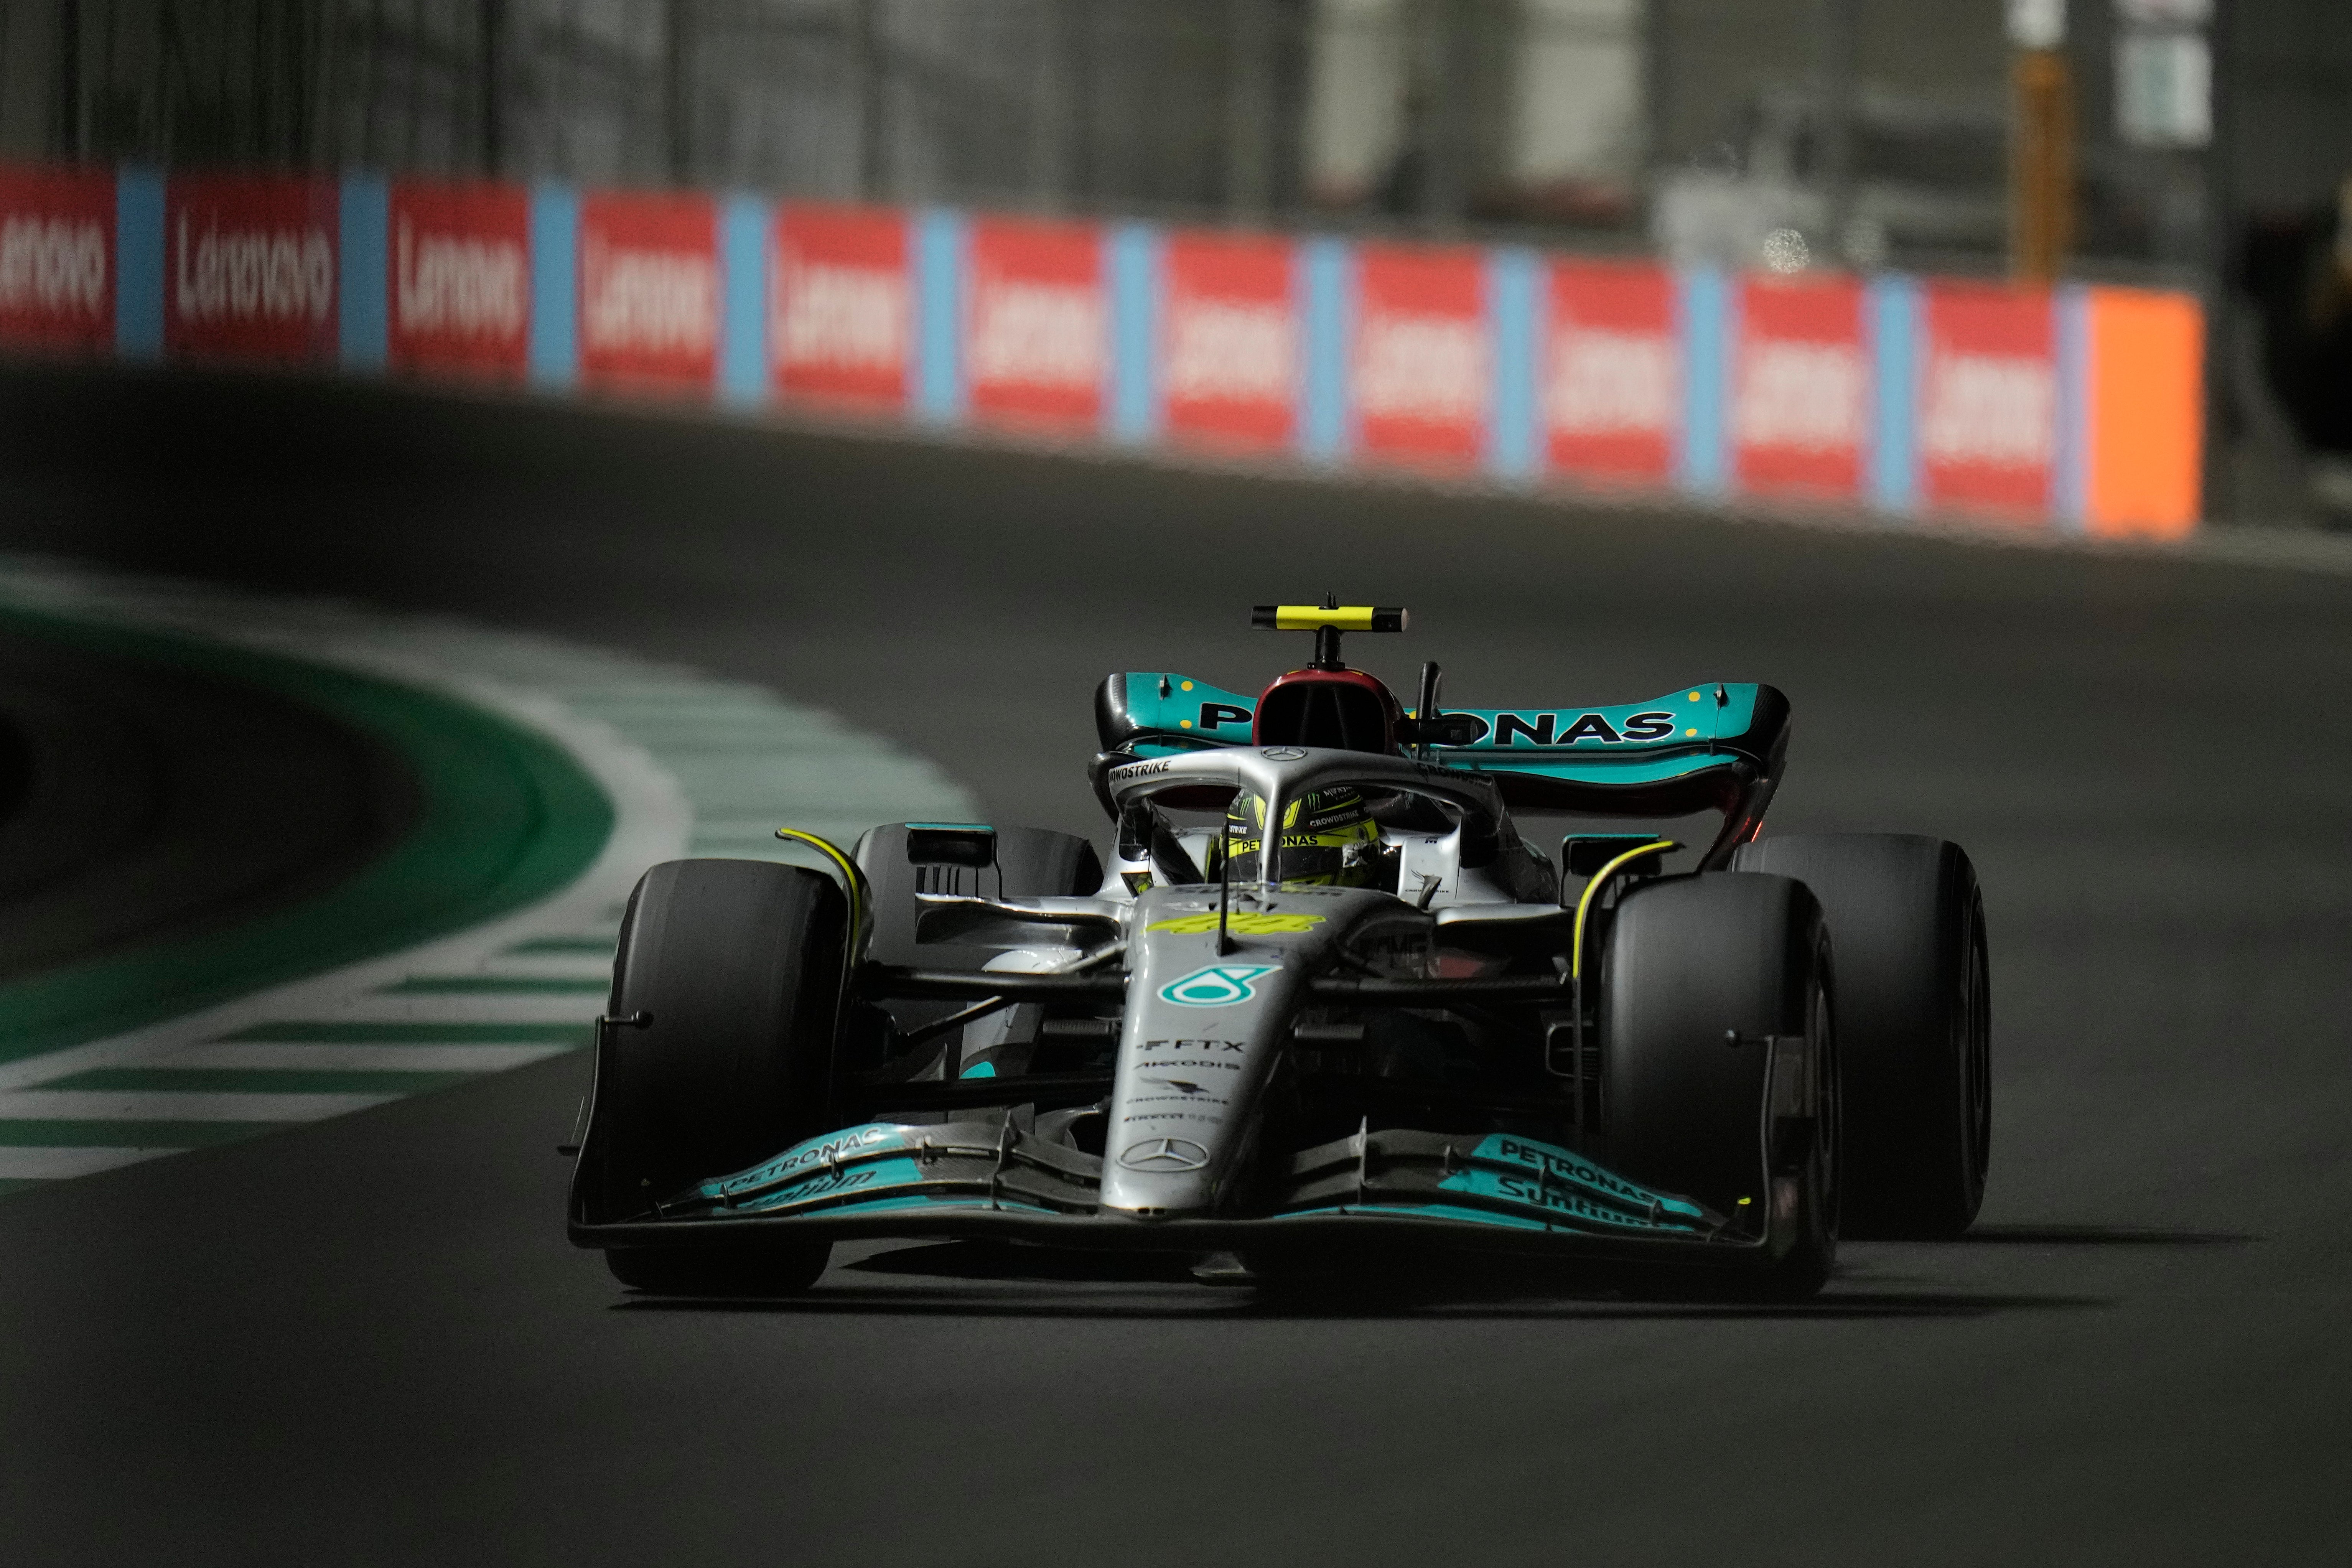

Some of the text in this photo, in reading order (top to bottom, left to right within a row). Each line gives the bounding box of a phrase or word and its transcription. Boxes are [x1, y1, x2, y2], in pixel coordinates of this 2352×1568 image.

[1309, 809, 1359, 827] CROWDSTRIKE
[1174, 1039, 1246, 1053] FTX
[728, 1129, 882, 1188] PETRONAS
[1500, 1139, 1655, 1202] PETRONAS
